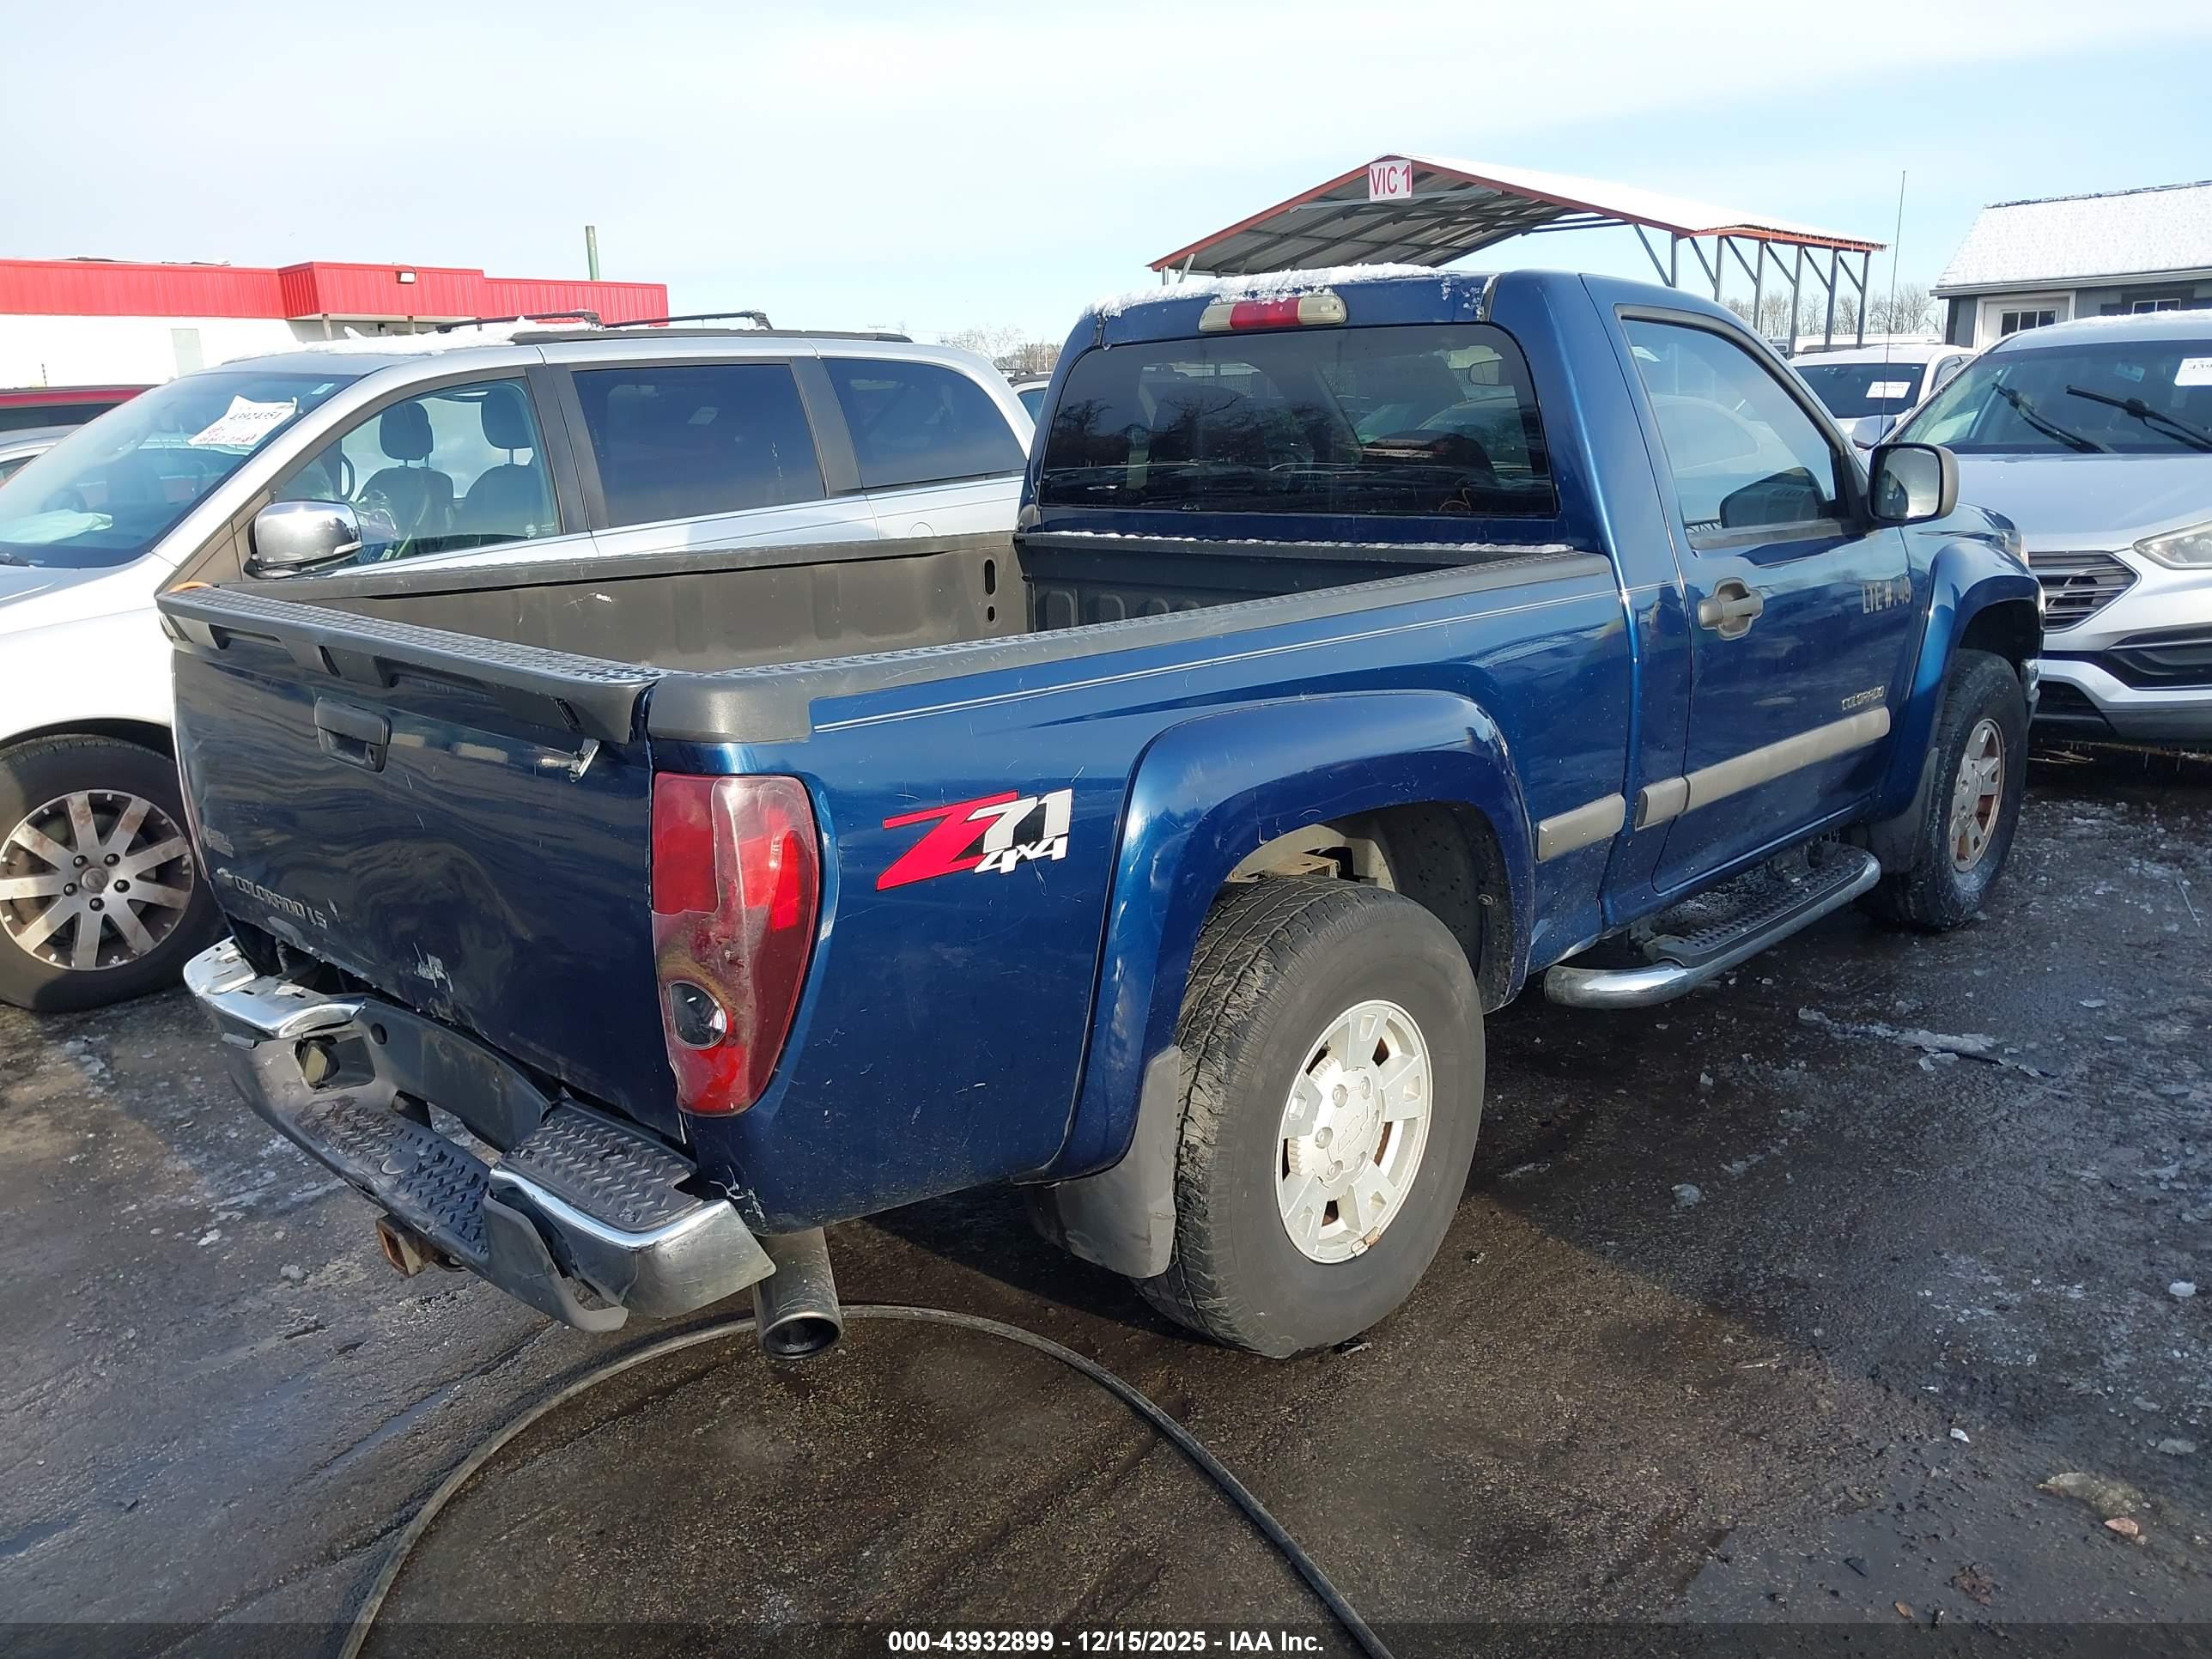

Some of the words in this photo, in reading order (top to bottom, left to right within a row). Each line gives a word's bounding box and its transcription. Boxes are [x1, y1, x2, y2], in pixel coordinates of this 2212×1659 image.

[1370, 165, 1398, 196] VIC
[1401, 164, 1411, 192] 1
[1862, 582, 1883, 614] LTE
[875, 787, 1075, 892] Z71
[233, 875, 306, 921] COLORADO
[306, 906, 328, 930] LS
